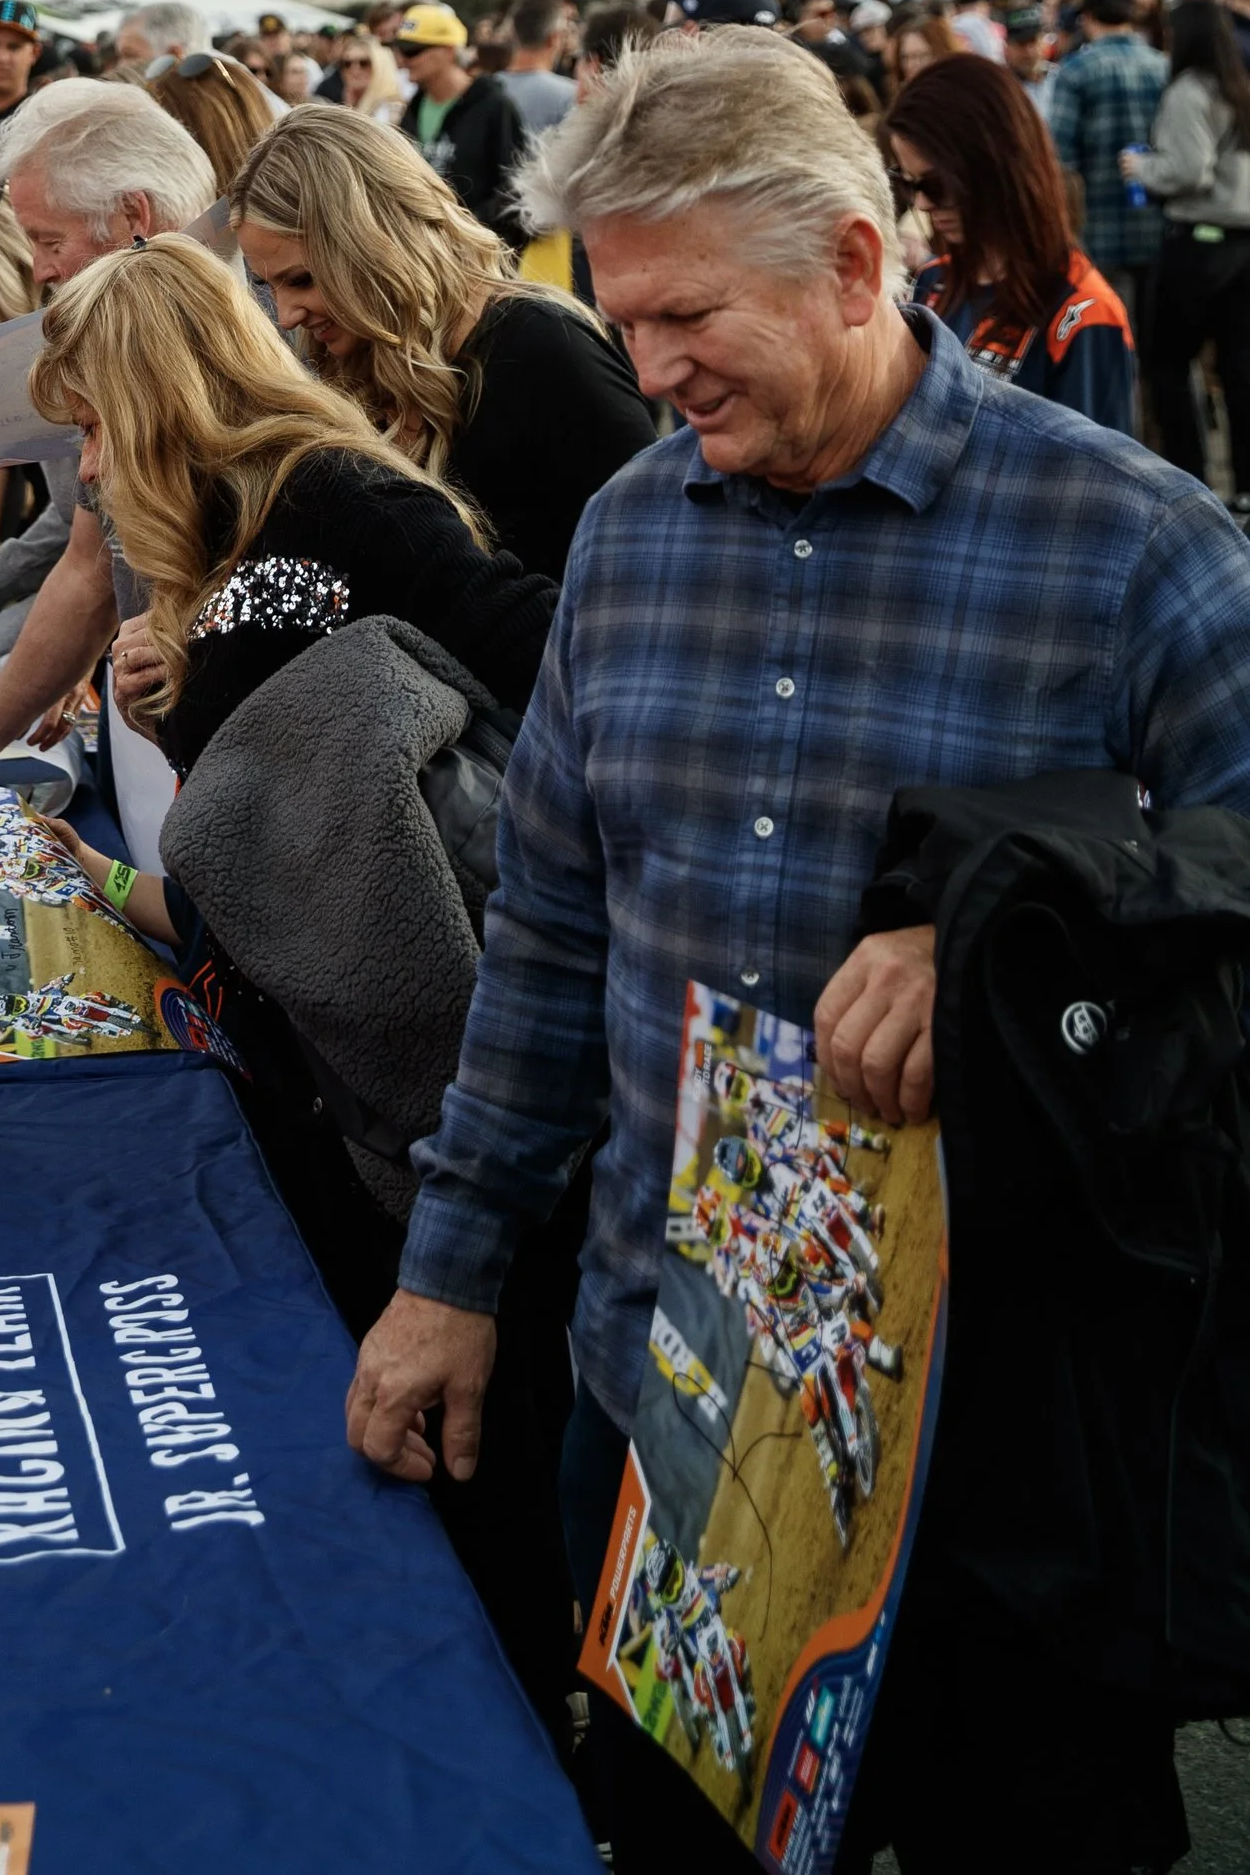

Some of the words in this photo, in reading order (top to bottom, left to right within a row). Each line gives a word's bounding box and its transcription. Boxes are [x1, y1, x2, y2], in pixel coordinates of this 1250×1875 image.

[99, 1274, 240, 1467] SUPERCROSS
[164, 1472, 266, 1530] JR.
[609, 1503, 637, 1600] POWERPARTS
